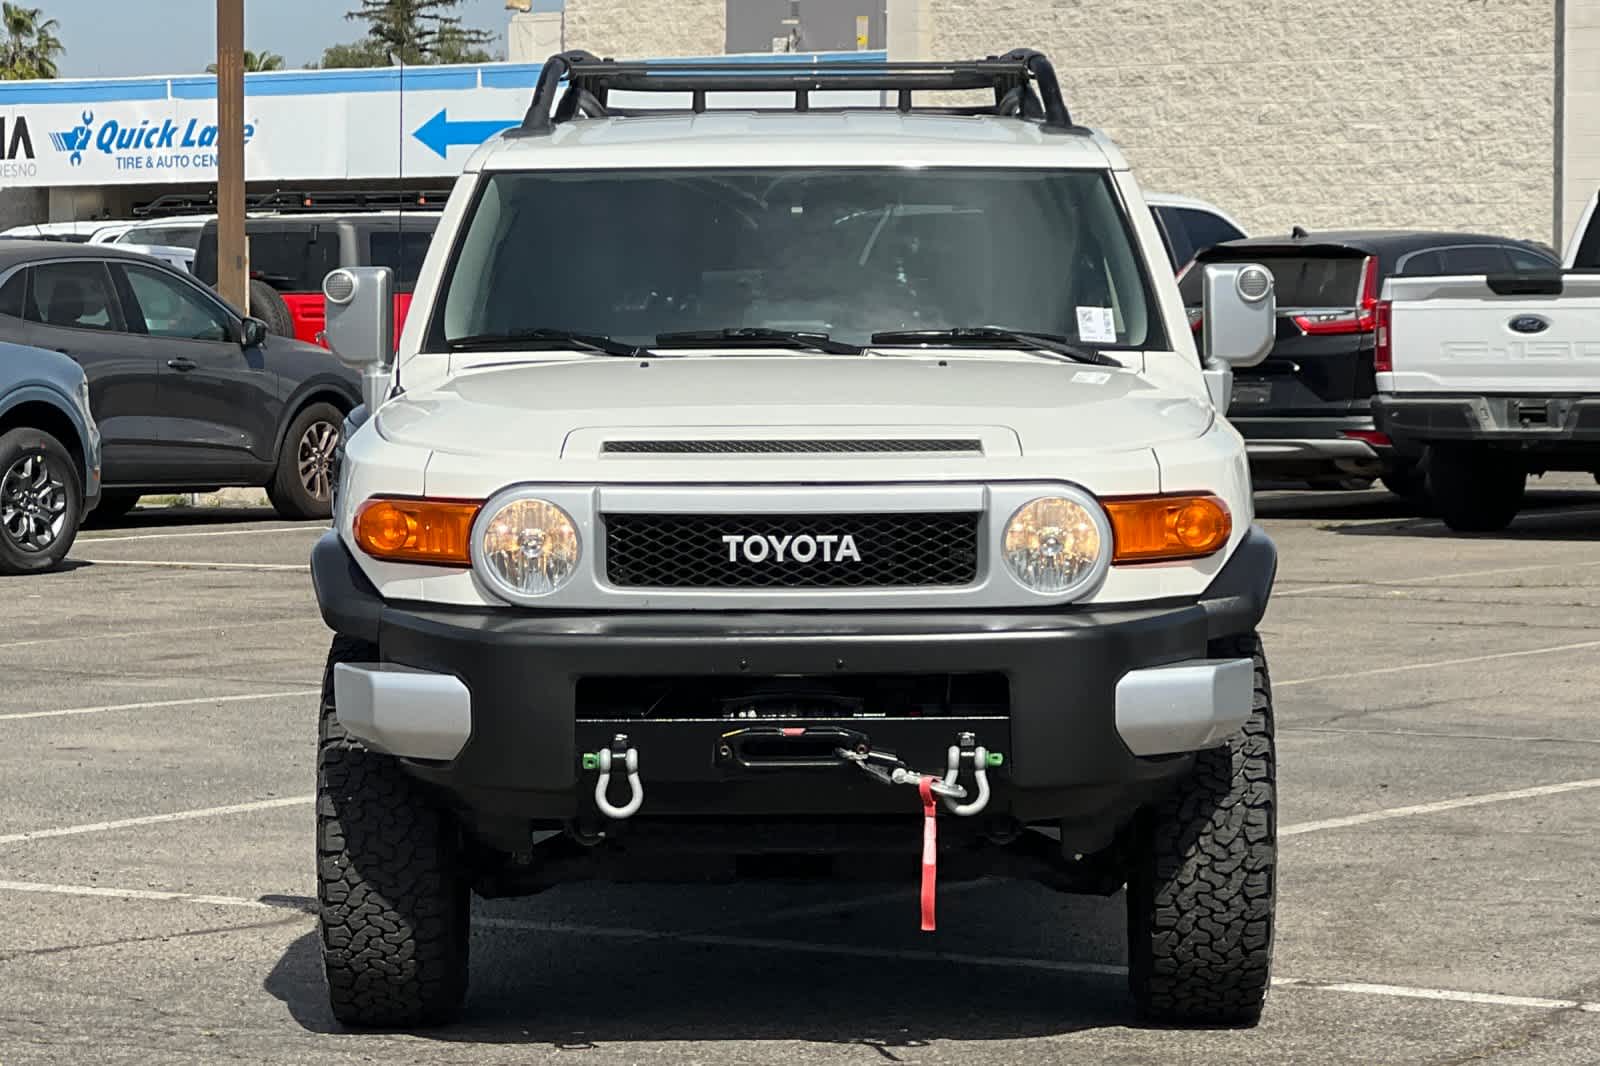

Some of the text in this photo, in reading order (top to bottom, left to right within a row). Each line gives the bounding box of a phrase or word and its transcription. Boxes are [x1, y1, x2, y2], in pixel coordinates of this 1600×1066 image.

[96, 118, 255, 154] Quick Lae
[116, 156, 143, 170] TIRE
[145, 155, 154, 169] &
[156, 154, 190, 169] AUTO
[722, 534, 862, 563] TOYOTA
